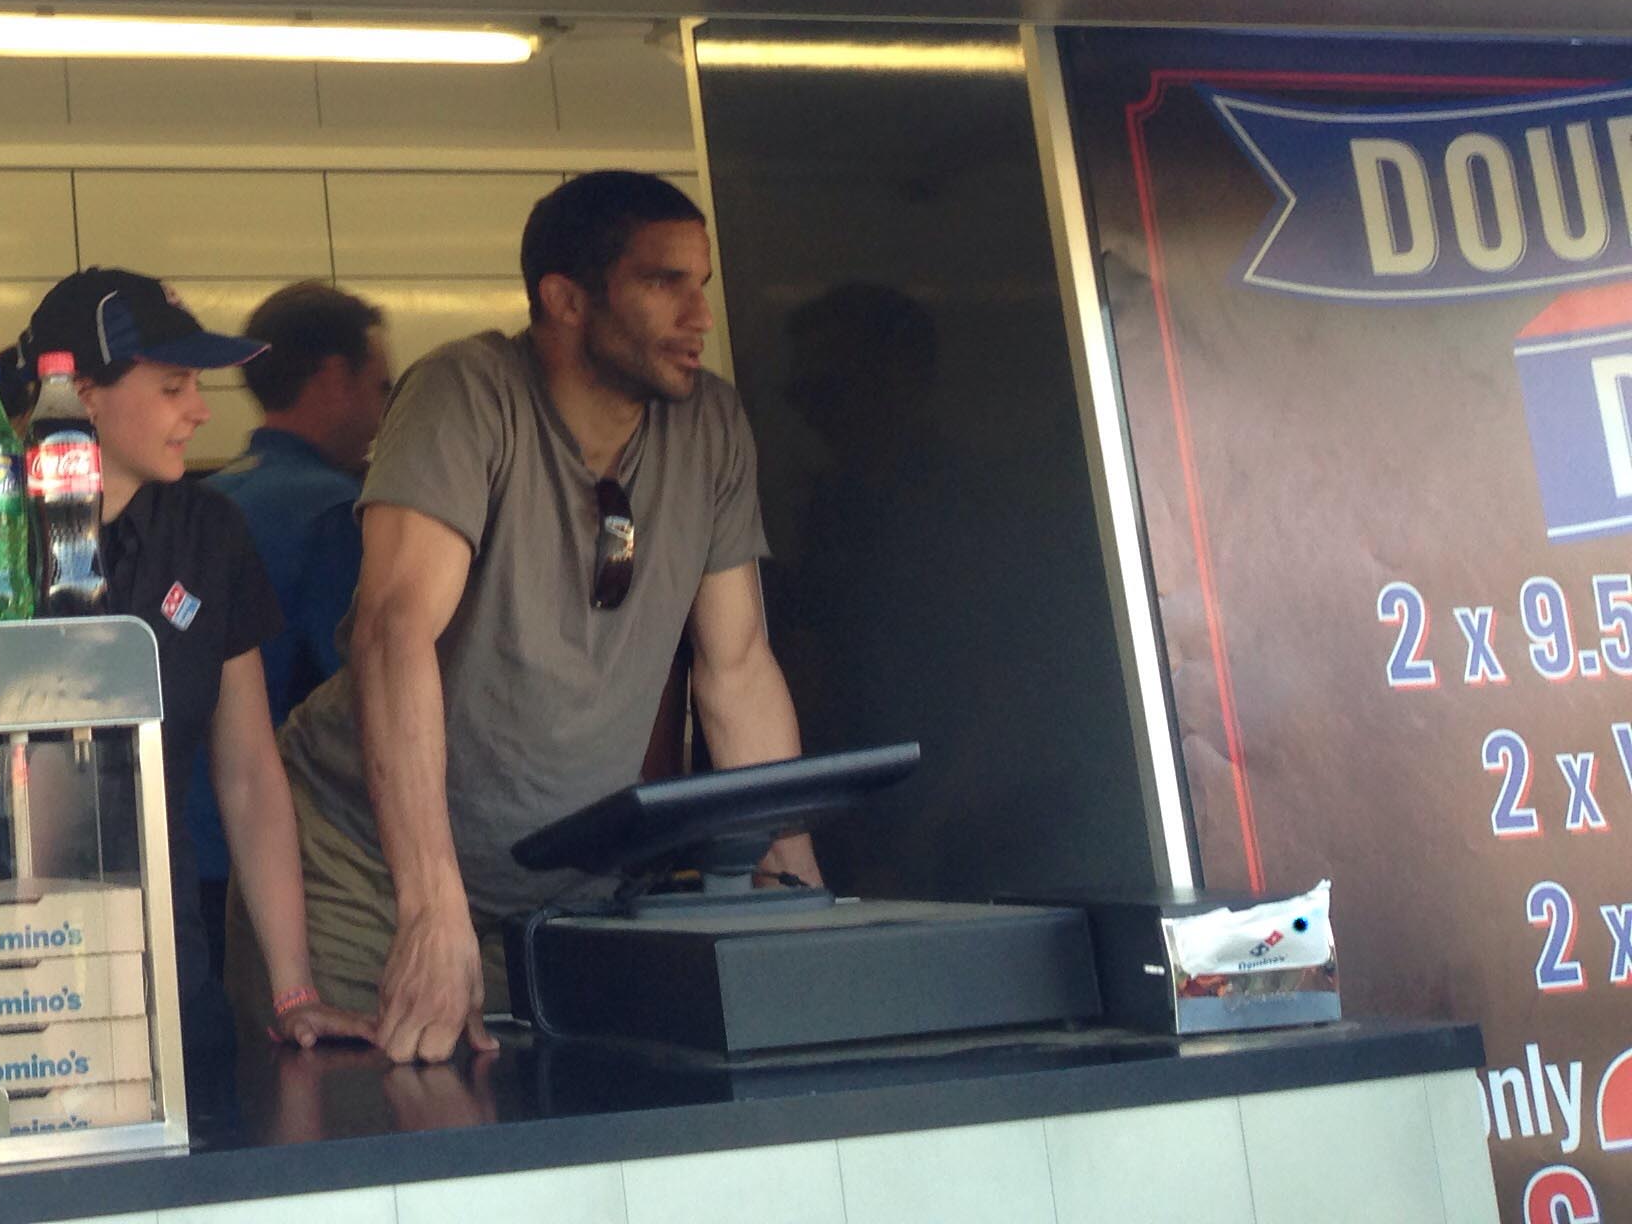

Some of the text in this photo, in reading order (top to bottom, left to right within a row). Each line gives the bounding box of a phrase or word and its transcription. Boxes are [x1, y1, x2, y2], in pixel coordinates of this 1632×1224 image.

[1377, 581, 1438, 688] 2
[1453, 605, 1509, 685] x
[1481, 728, 1538, 836] 2
[1526, 879, 1587, 992] 2
[1476, 1042, 1583, 1155] nly
